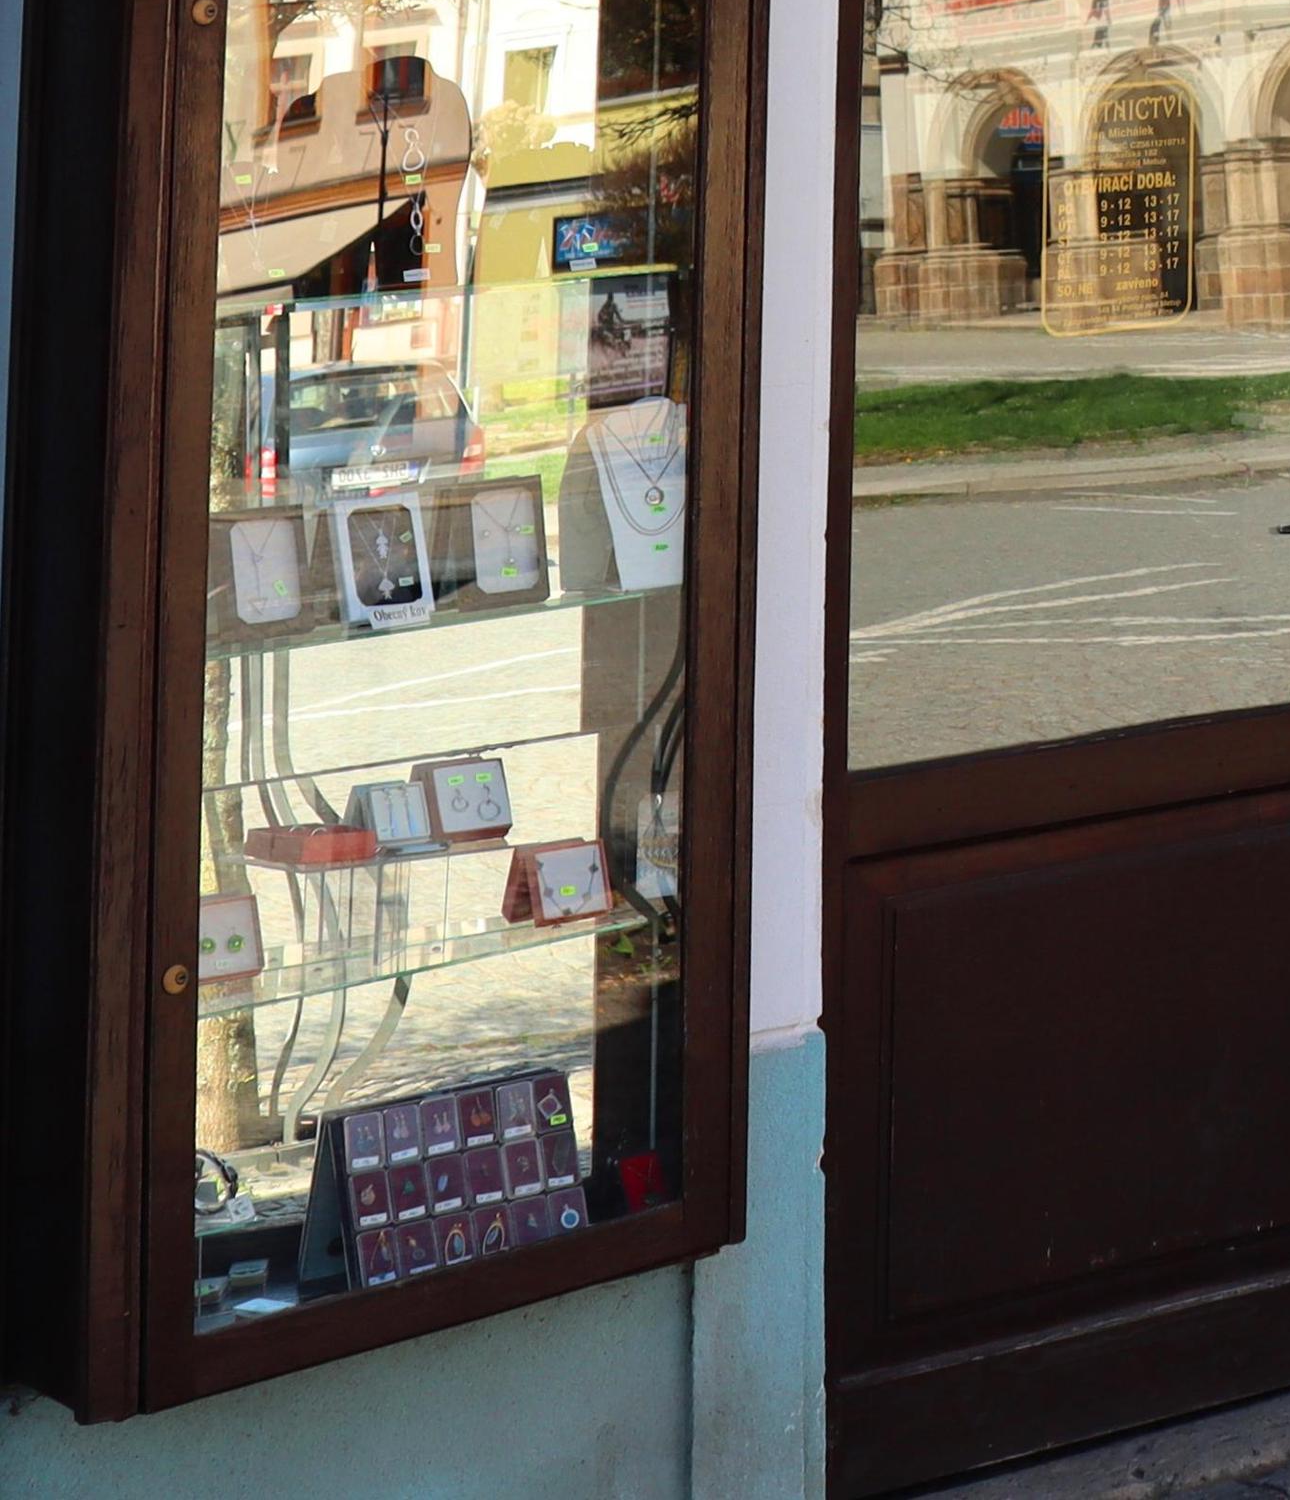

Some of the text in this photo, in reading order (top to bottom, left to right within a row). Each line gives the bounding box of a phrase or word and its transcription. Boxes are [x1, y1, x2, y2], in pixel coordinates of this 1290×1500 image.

[1063, 171, 1176, 198] OTEVÍRACÍ DOBA:
[1100, 200, 1108, 212] 9
[1118, 198, 1131, 210] 12
[1144, 195, 1157, 207] 13
[1167, 193, 1180, 205] 17
[1100, 216, 1108, 228] 9
[1118, 214, 1131, 226] 12
[1144, 211, 1157, 223] 13
[1167, 209, 1180, 221] 17
[1100, 232, 1108, 244] 9
[1118, 230, 1131, 242] 12
[1144, 228, 1157, 240] 13
[1167, 225, 1180, 237] 17
[1100, 248, 1108, 260] 9
[1118, 246, 1131, 258] 12
[1144, 244, 1157, 256] 13
[1167, 241, 1180, 253] 17
[1100, 265, 1108, 277] 9
[1118, 263, 1131, 275] 12
[1144, 260, 1157, 272] 13
[1167, 257, 1180, 269] 17
[1115, 277, 1159, 291] zavřeno
